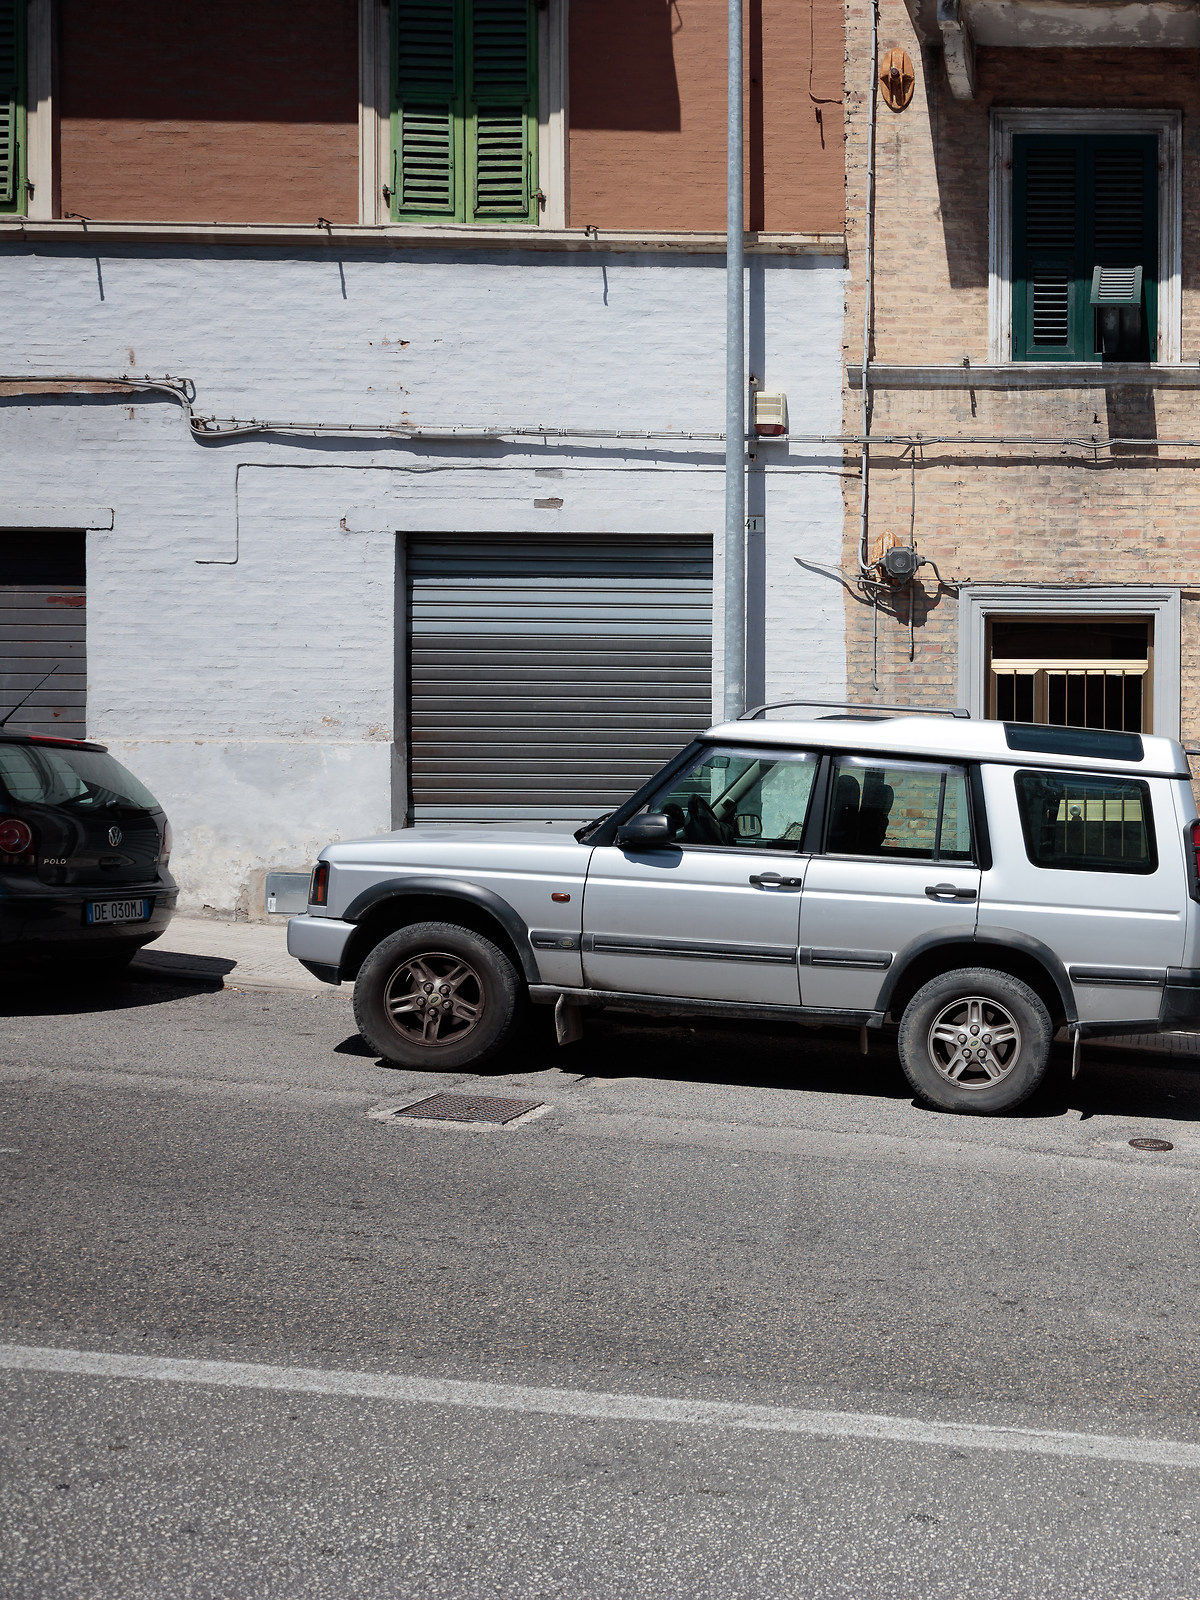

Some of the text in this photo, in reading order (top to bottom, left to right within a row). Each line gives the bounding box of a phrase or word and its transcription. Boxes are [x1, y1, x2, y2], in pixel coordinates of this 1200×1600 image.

[744, 518, 757, 530] 41
[94, 901, 143, 921] DE 030MJ
